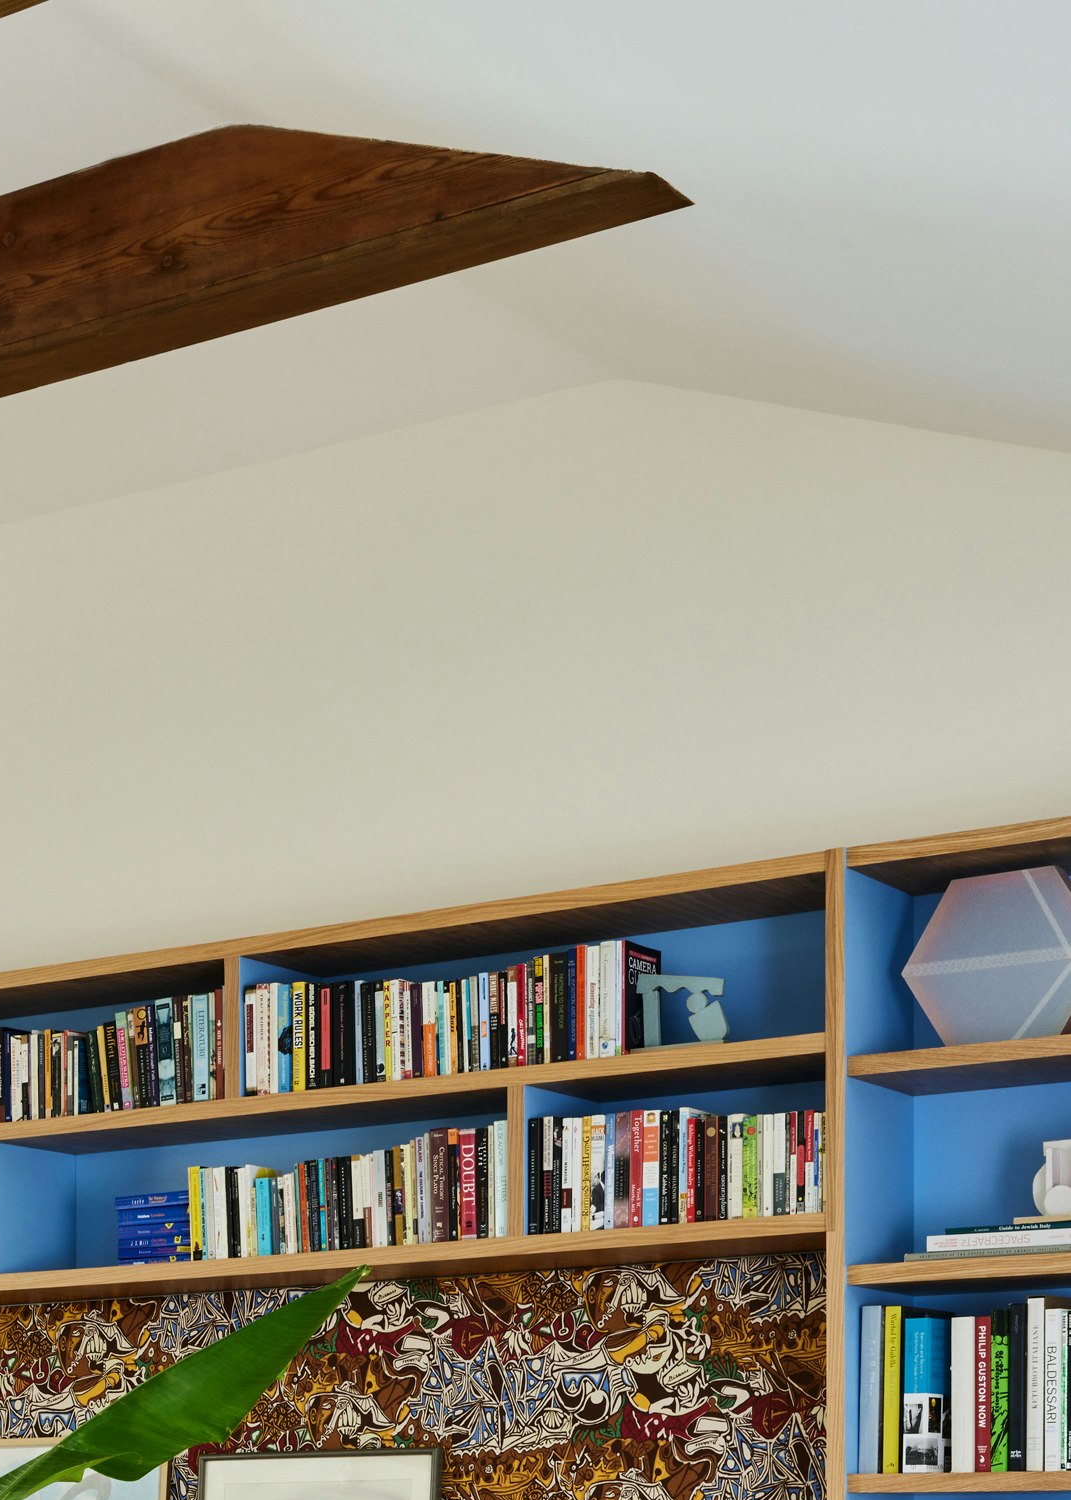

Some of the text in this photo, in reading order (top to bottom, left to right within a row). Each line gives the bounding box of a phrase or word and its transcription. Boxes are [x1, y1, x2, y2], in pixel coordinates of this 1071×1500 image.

[628, 956, 657, 974] CAMERA
[106, 1026, 116, 1057] Buffett
[294, 992, 303, 1049] WORK RULES!
[633, 1115, 642, 1152] Together
[462, 1144, 475, 1205] DOUBT
[1047, 1346, 1057, 1423] BALDESSARI
